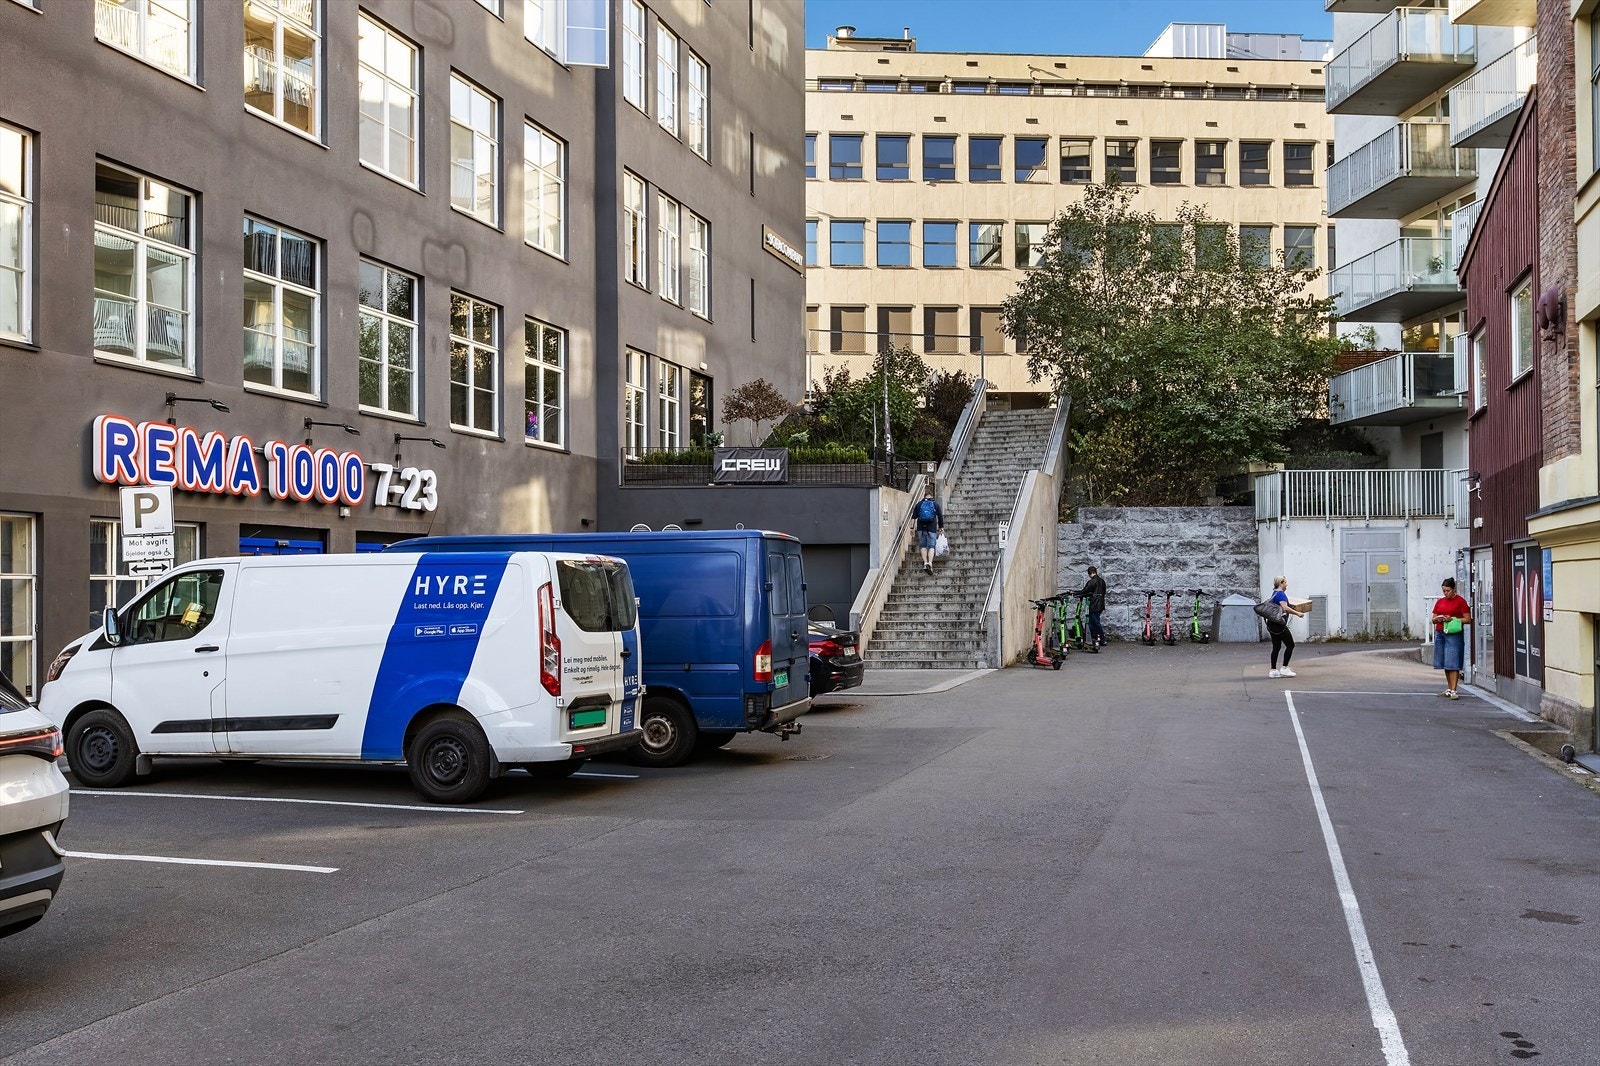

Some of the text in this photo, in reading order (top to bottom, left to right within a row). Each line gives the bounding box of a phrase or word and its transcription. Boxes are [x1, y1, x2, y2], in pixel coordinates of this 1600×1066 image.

[93, 414, 366, 506] REMA 1000
[721, 458, 780, 471] CREW
[371, 463, 438, 512] 7-23
[133, 492, 160, 529] P
[146, 538, 168, 547] avgift
[414, 574, 488, 595] HYRE
[443, 601, 454, 609] Lås
[470, 602, 485, 610] Kjør.
[563, 666, 580, 674] Enkelt
[624, 675, 638, 686] HYRE
